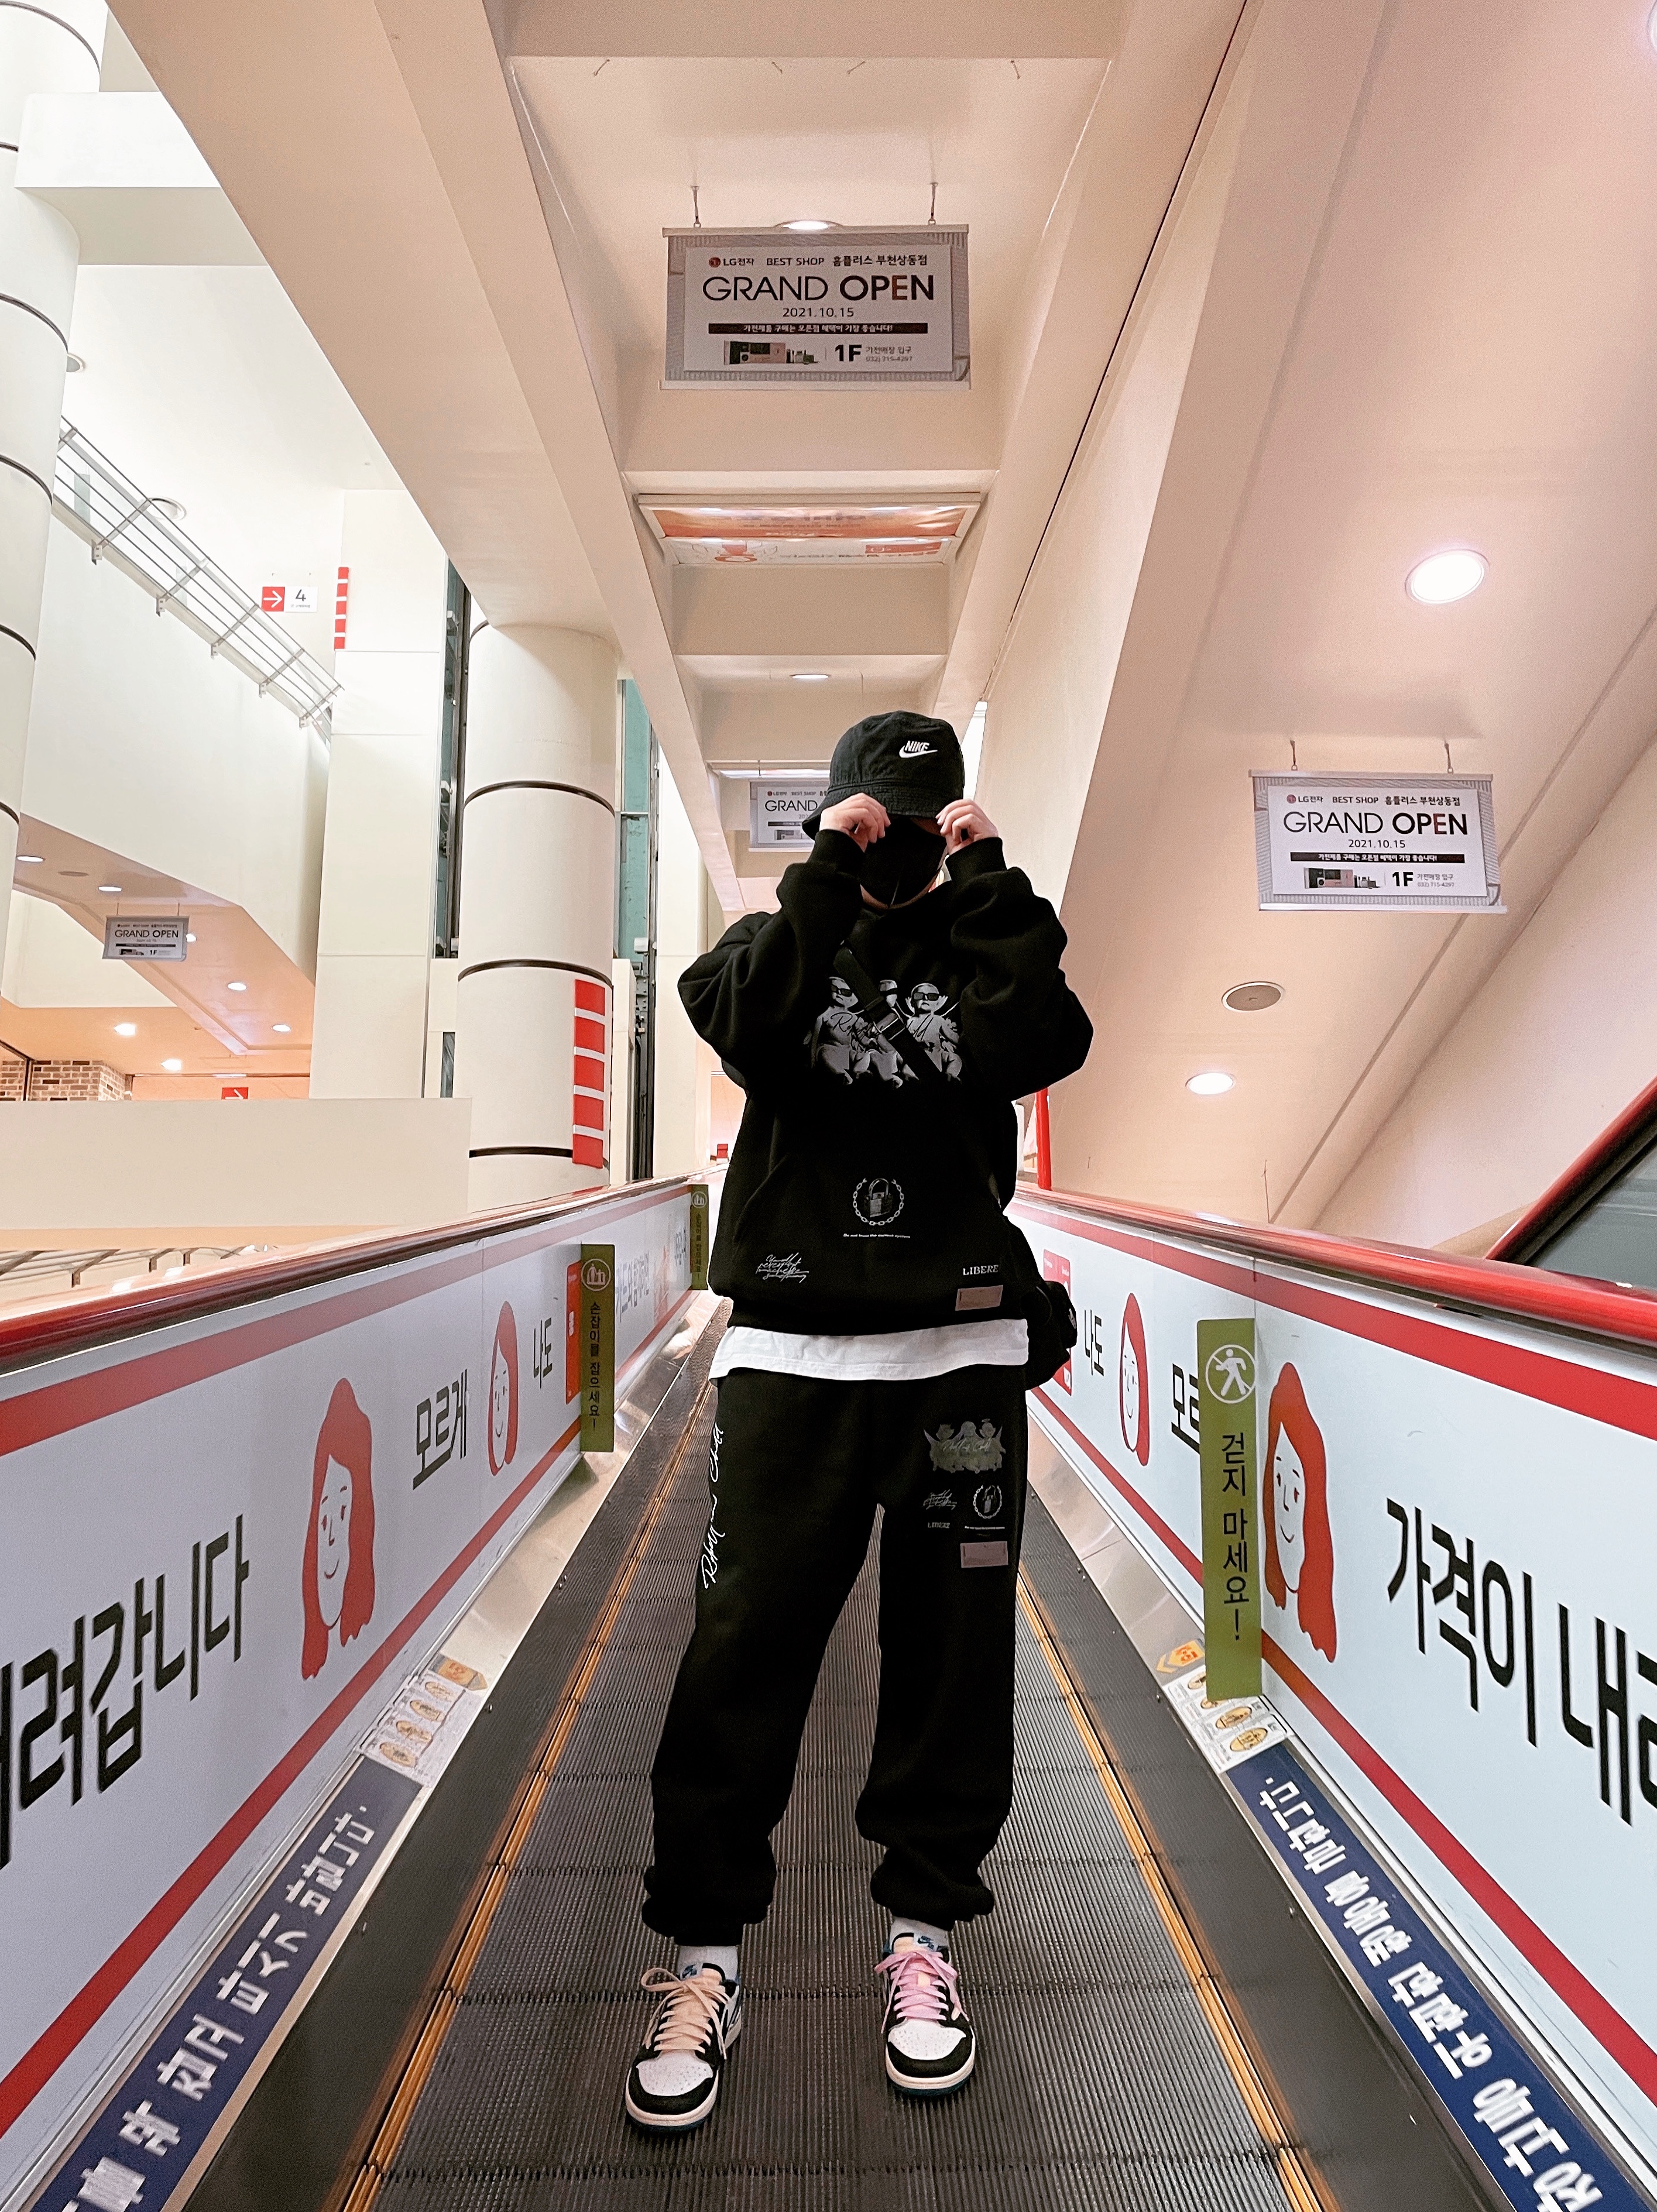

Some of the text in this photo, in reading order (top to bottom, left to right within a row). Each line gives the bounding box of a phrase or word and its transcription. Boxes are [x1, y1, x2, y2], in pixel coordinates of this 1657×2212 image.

[723, 255, 928, 267] LG전자 BEST SHOP 홈플러스 부천상동점
[702, 275, 934, 301] GRAND OPEN
[782, 307, 855, 318] 2021.10.15
[835, 344, 862, 362] 1F
[295, 589, 307, 602] 4
[904, 740, 929, 753] NIKE
[764, 800, 818, 812] GRAND
[1385, 796, 1418, 805] 홈플러스
[1419, 796, 1460, 806] 부천상동점
[1283, 812, 1468, 835] GRAND OPEN
[1348, 839, 1406, 849] 2021.10.15
[1392, 871, 1414, 887] 1F
[115, 929, 150, 937] GRAND
[963, 1265, 999, 1276] LIBERE
[589, 1301, 601, 1357] 손잡이를
[1222, 1432, 1250, 1641] 걷지 마세요!
[1084, 1308, 1104, 1376] 나도
[1387, 1497, 1538, 1748] 가격이
[1557, 1602, 1657, 1828] 내
[0, 1513, 249, 1871] 려갑니다
[412, 1369, 468, 1490] 모르게
[533, 1317, 553, 1389] 나도
[1258, 1776, 1347, 1876] 금합니다.
[156, 2013, 245, 2102] 잡고
[217, 1912, 308, 2015] 타시기
[285, 1805, 375, 1916] 바랍니다.
[1387, 1960, 1493, 2080] 위험한
